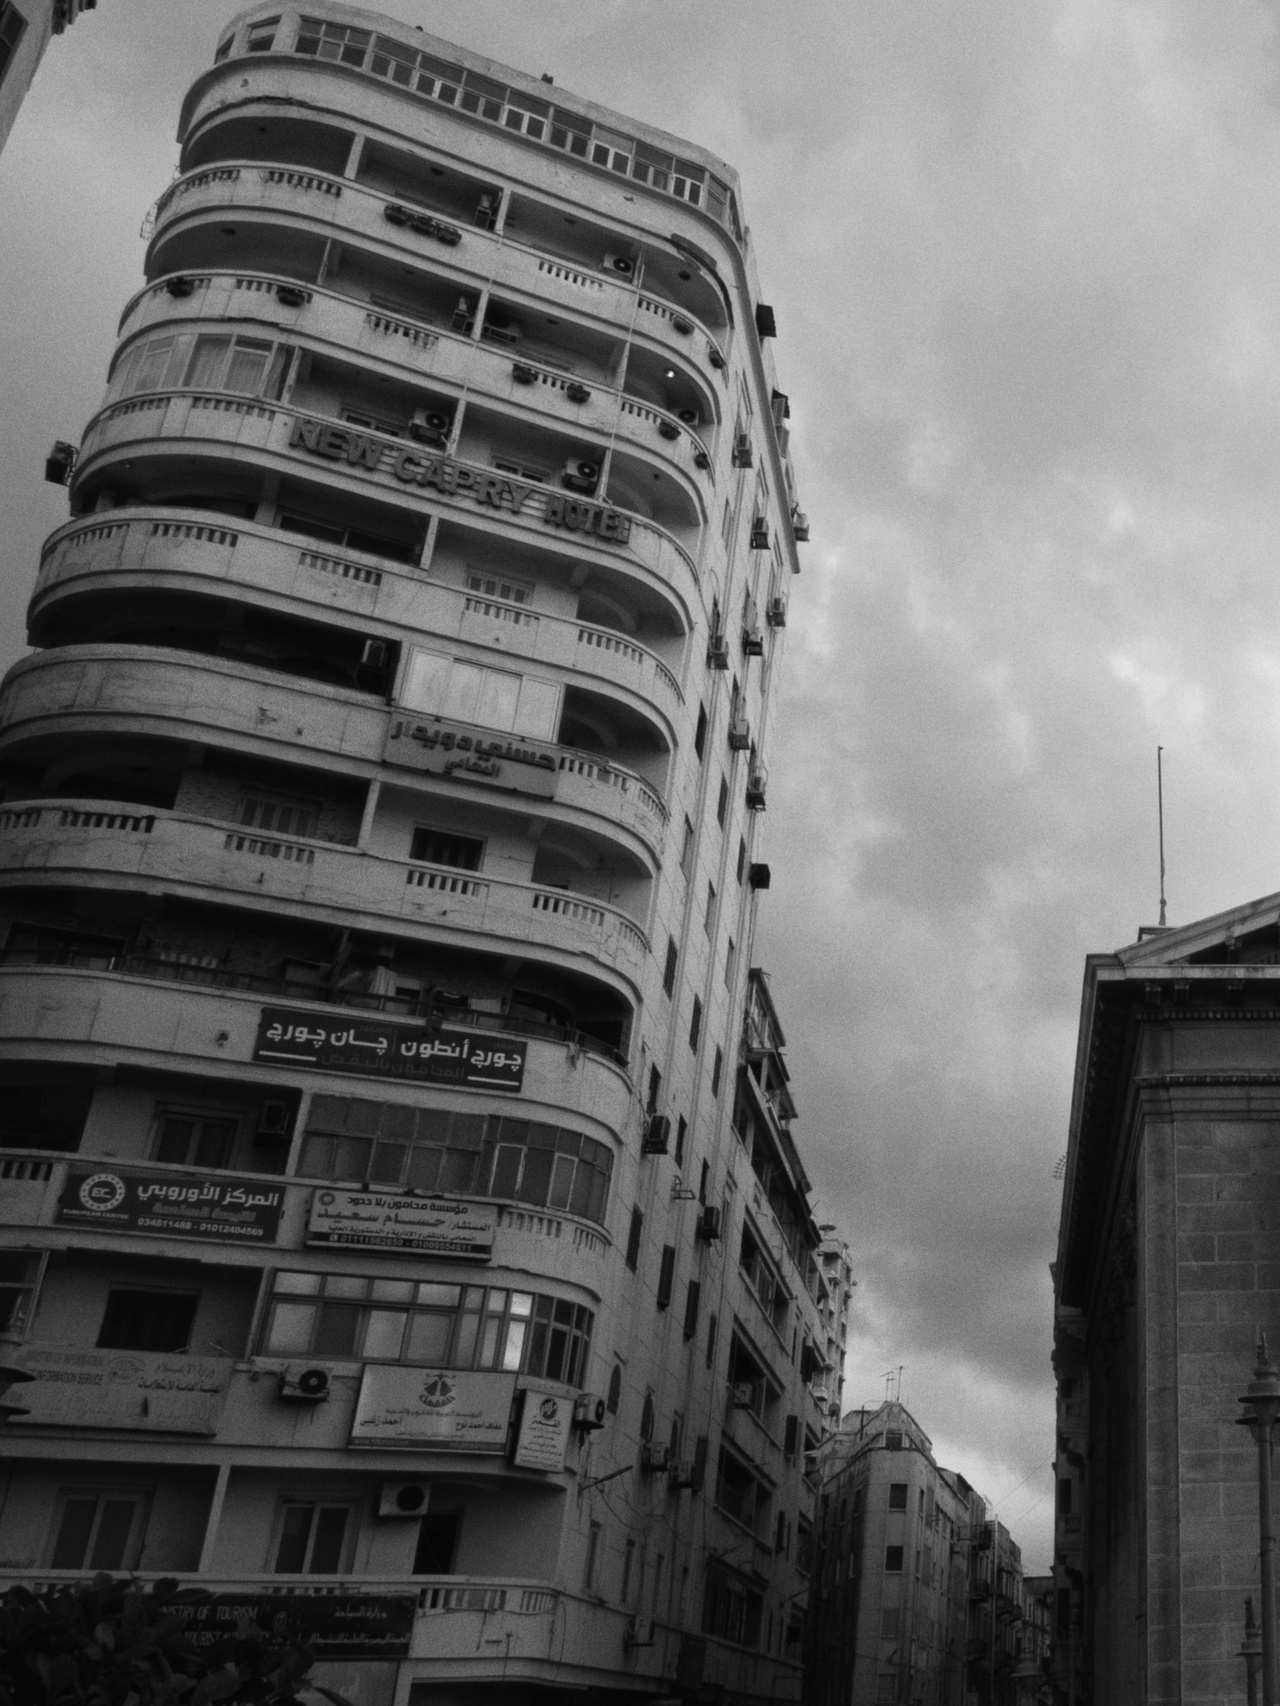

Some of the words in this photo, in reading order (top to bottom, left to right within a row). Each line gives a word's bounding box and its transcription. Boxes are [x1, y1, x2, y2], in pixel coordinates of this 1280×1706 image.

[289, 417, 384, 471] NEW
[394, 451, 533, 514] CAPRY
[545, 494, 631, 543] HOTEL
[91, 1187, 112, 1198] EC
[222, 1187, 280, 1208] المركز
[216, 1605, 259, 1621] TOURISM
